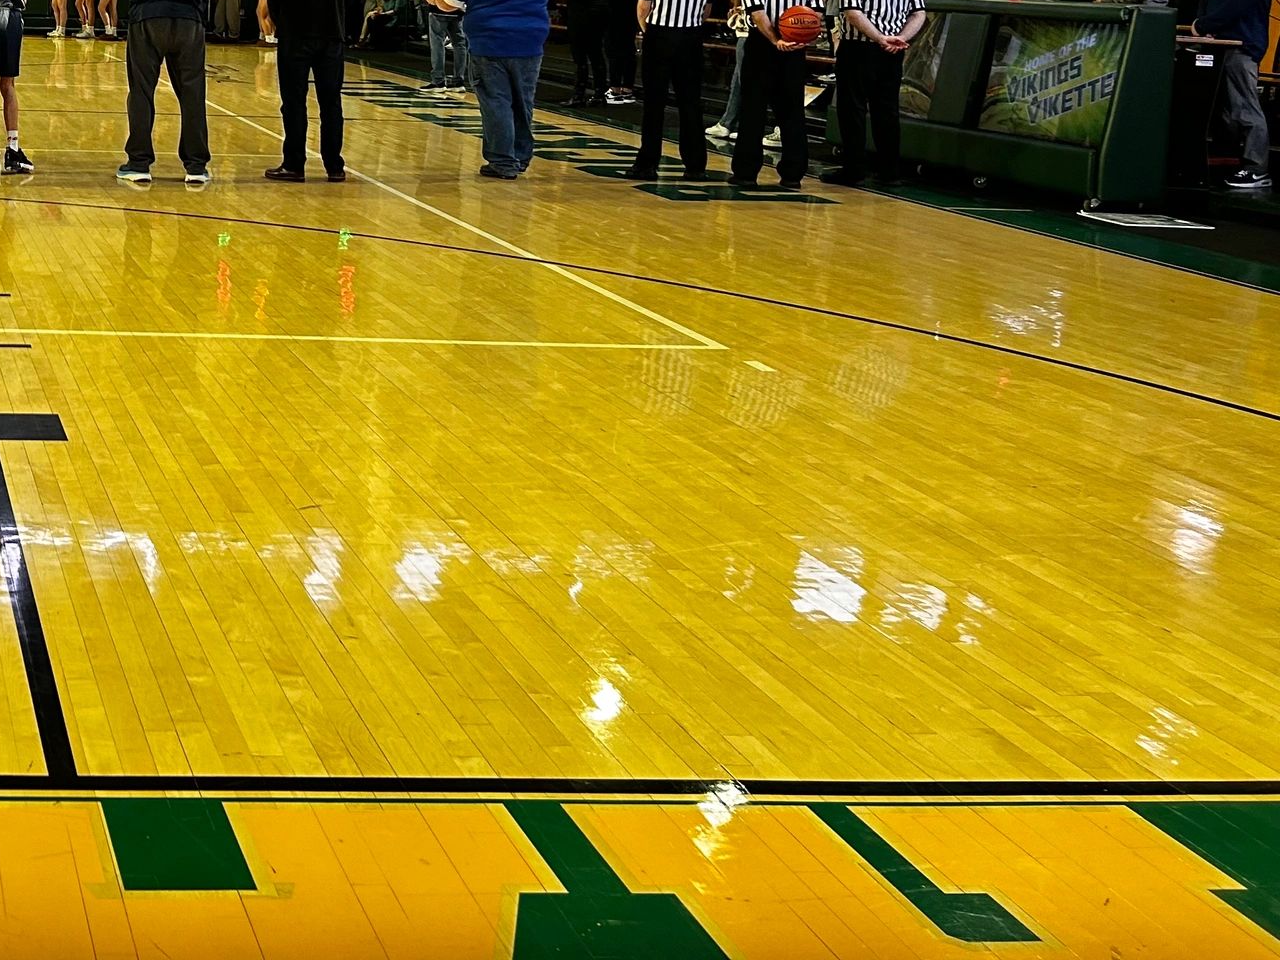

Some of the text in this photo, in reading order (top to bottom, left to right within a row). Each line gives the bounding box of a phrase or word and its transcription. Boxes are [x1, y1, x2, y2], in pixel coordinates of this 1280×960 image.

[1024, 33, 1097, 72] HOME OF THE
[1006, 55, 1083, 103] VIKINGS
